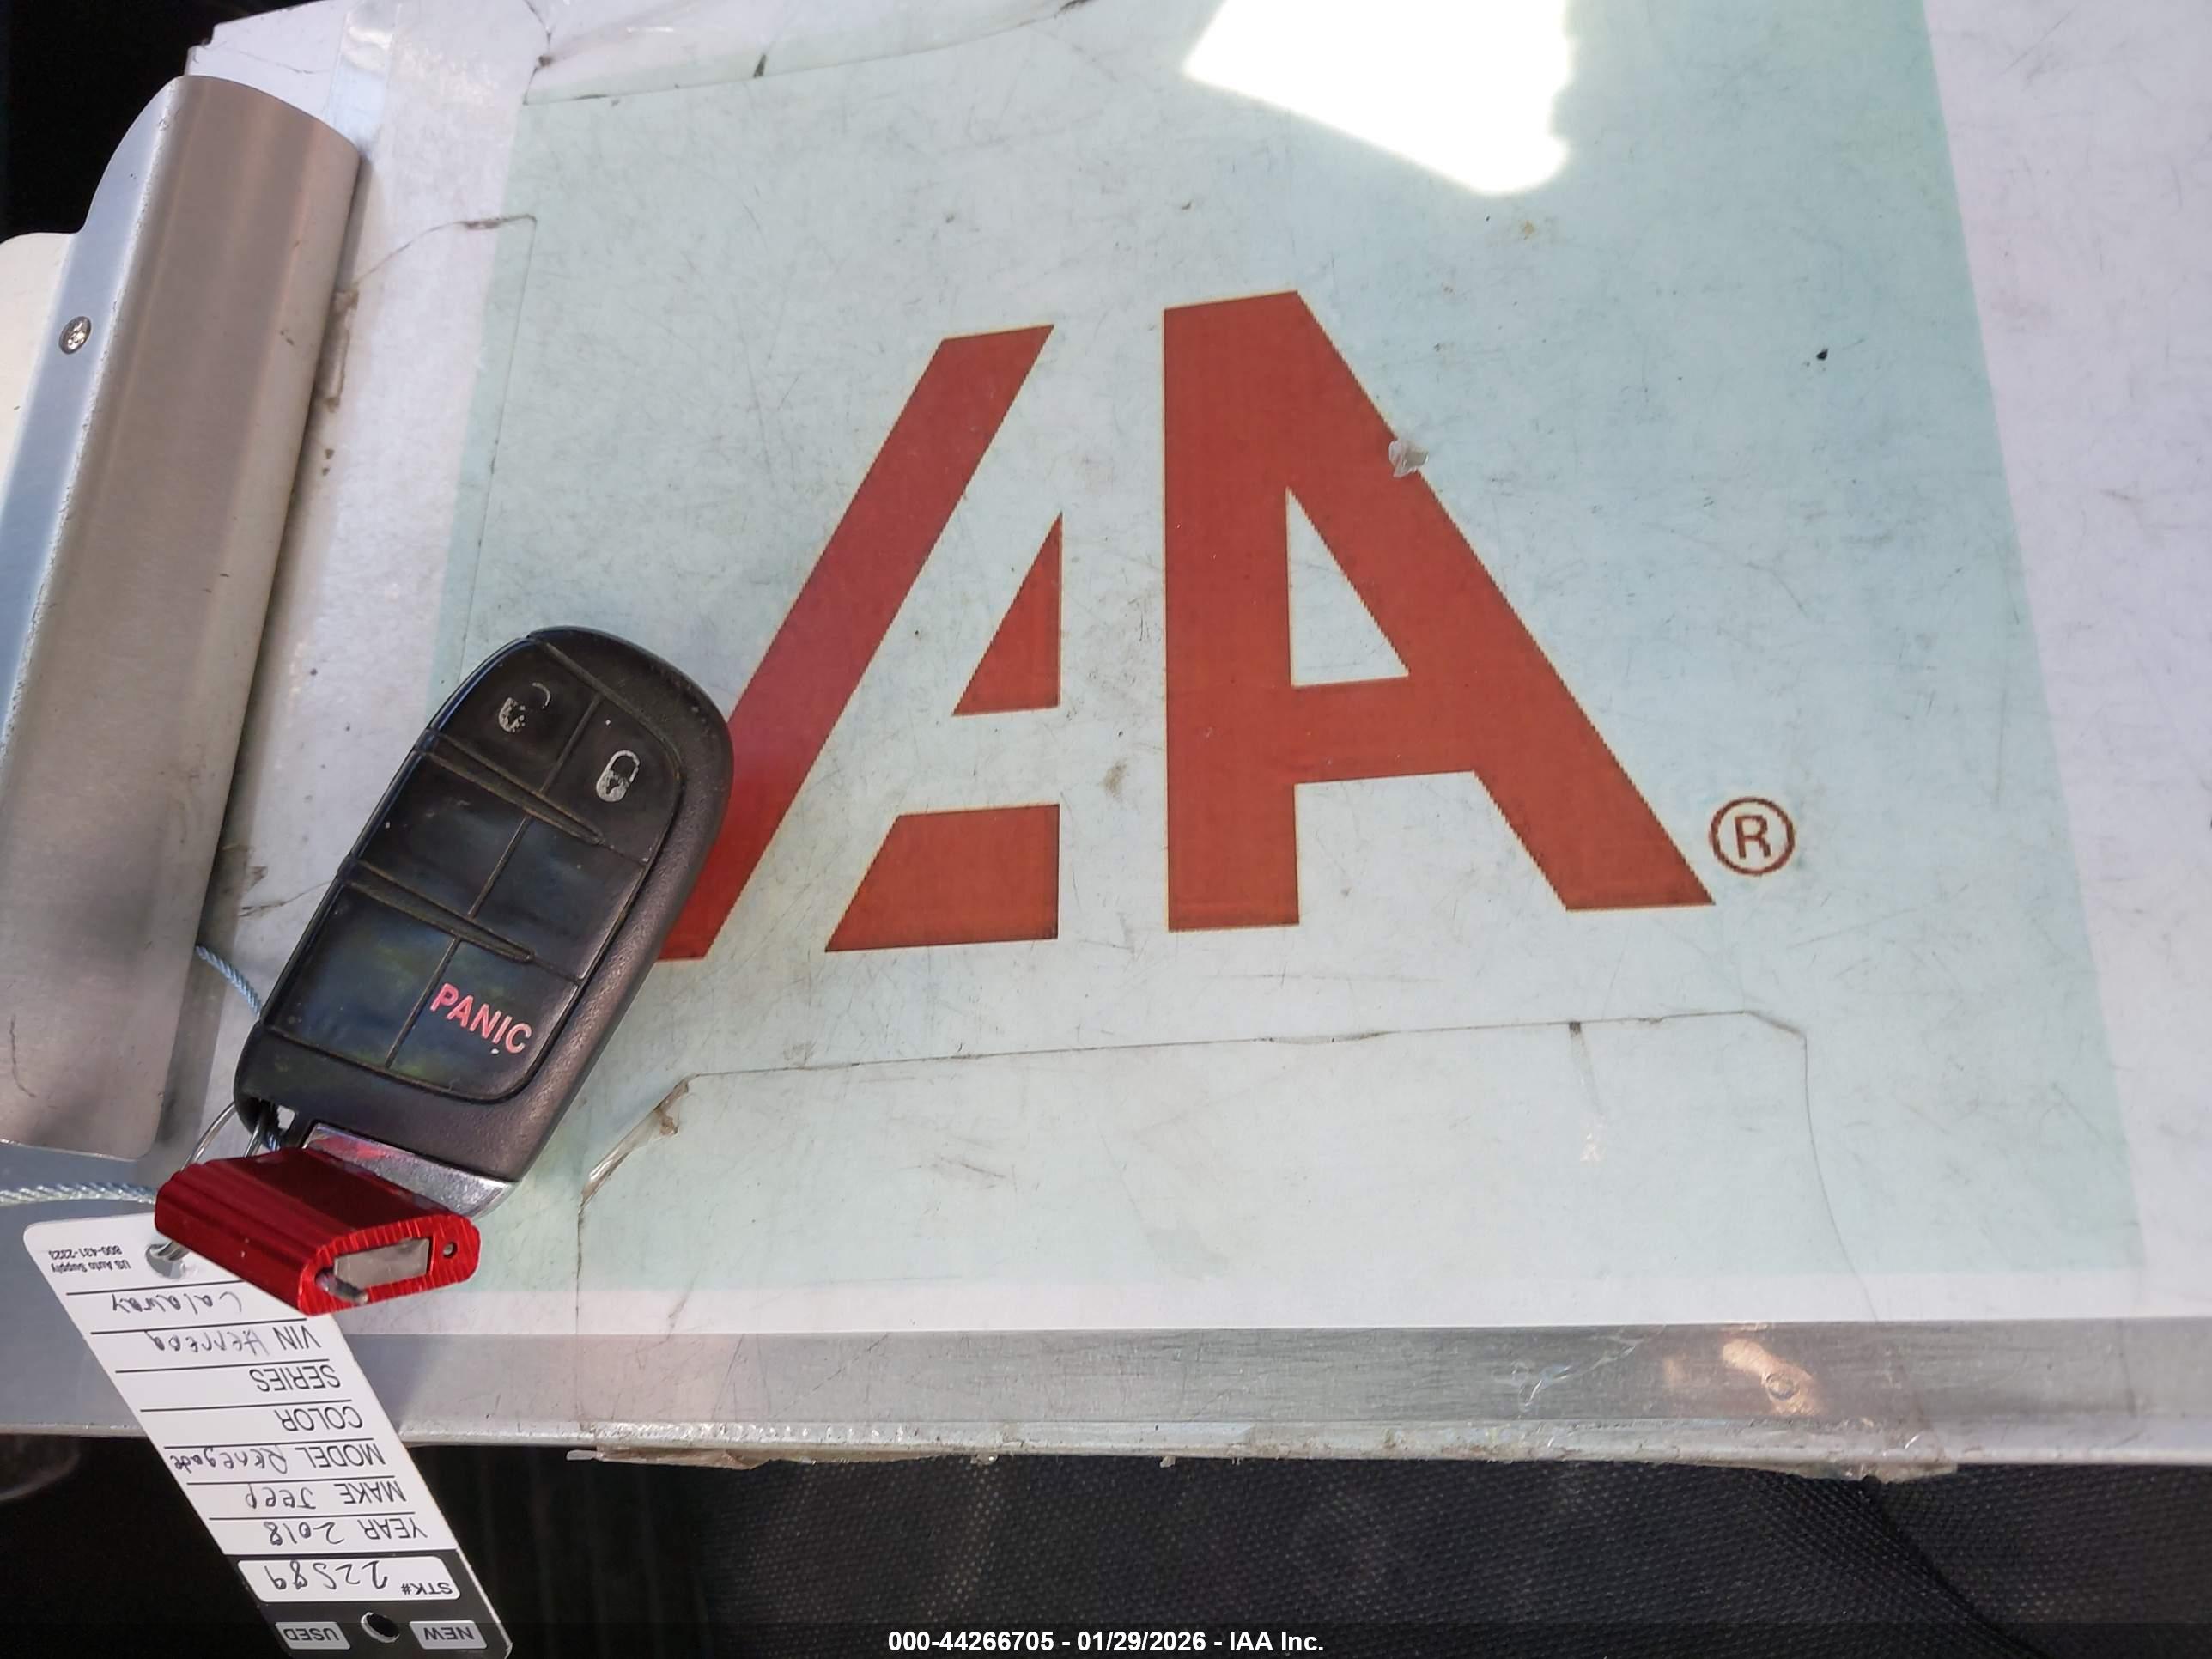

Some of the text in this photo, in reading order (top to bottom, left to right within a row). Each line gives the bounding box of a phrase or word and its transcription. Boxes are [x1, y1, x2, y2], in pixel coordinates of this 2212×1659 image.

[429, 982, 532, 1054] PANIC
[51, 1259, 131, 1274] US Auto Supply
[274, 1325, 323, 1349] VIN
[249, 1365, 343, 1392] SERIES
[274, 1406, 364, 1430] COLOR
[295, 1443, 386, 1468] MODEL
[246, 1483, 316, 1510] Jeep
[334, 1482, 407, 1504] MAKE
[264, 1521, 345, 1546] 2018
[359, 1519, 428, 1540] YEAR
[401, 1582, 453, 1595] STK#
[283, 1626, 339, 1642] USED
[422, 1626, 474, 1642] NEW
